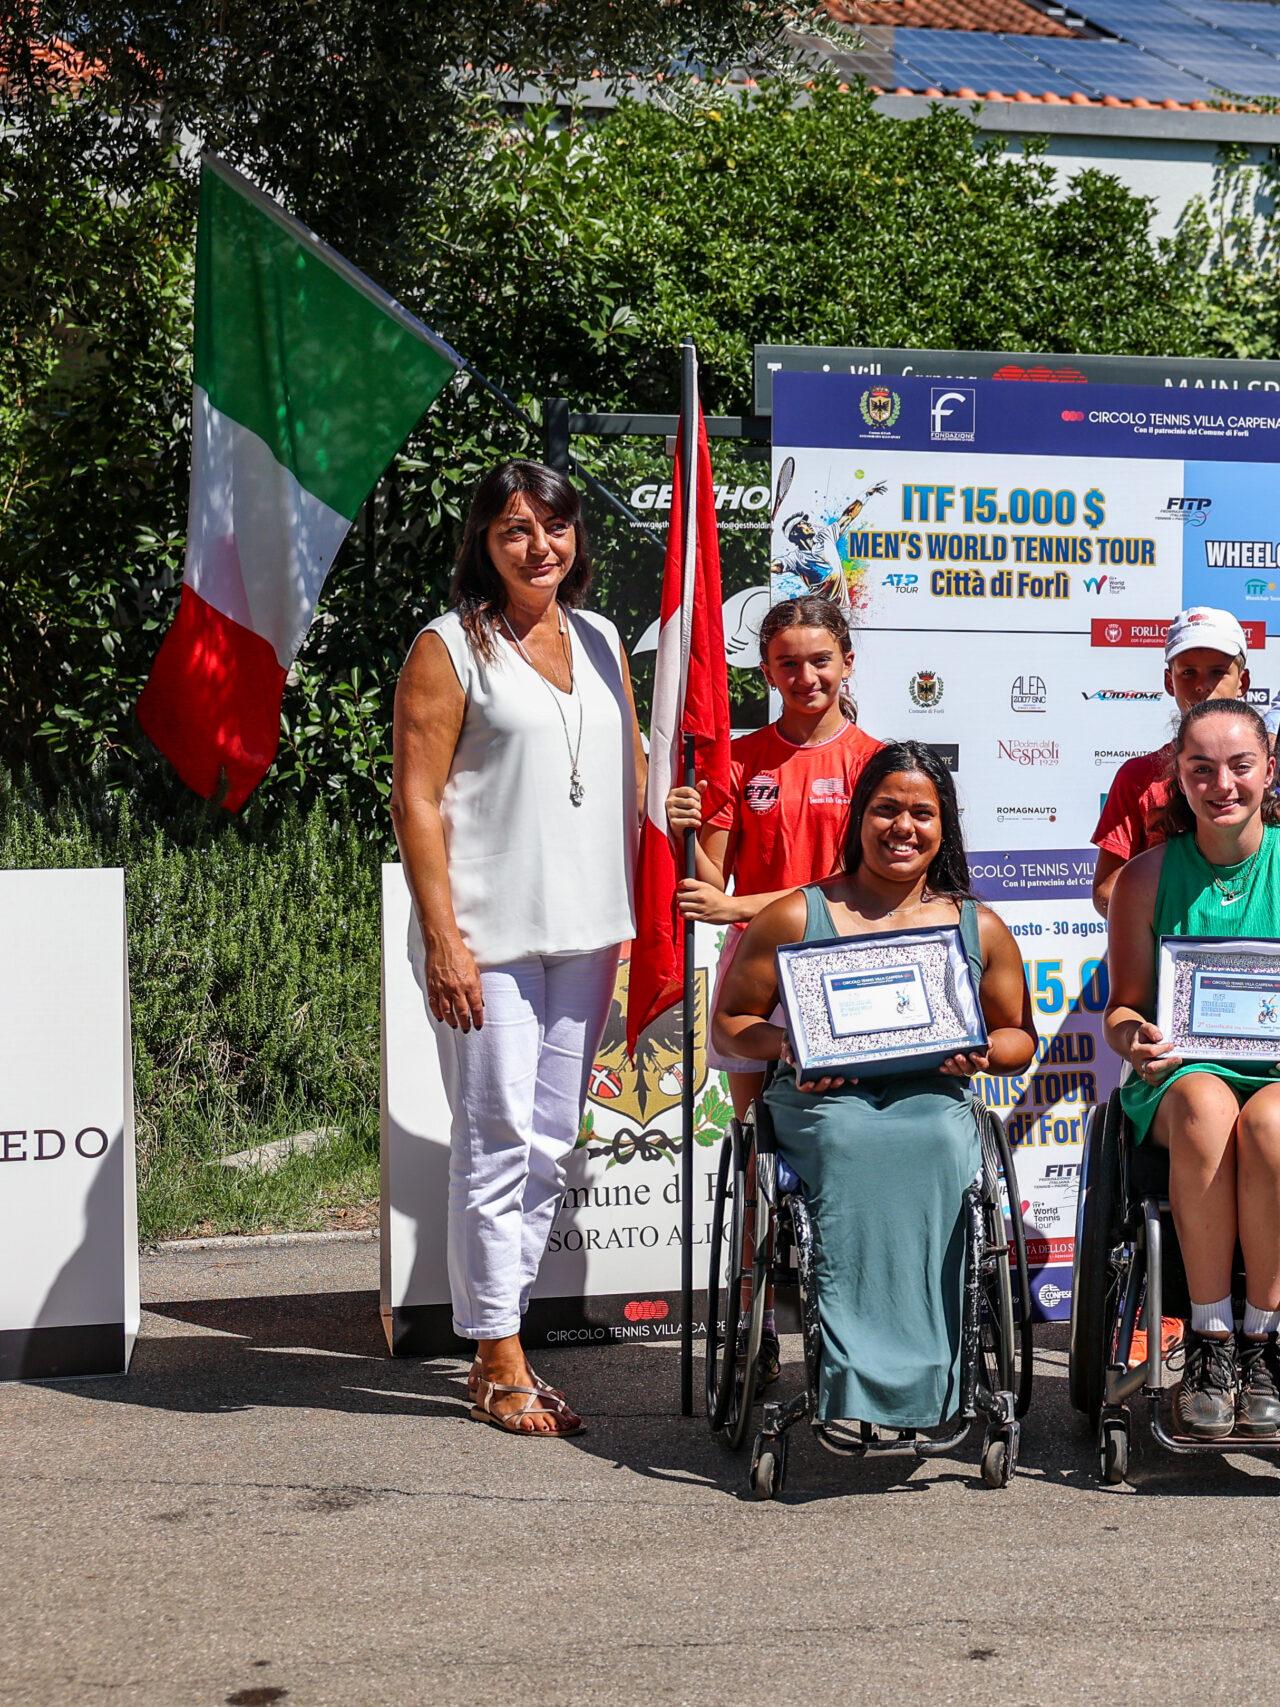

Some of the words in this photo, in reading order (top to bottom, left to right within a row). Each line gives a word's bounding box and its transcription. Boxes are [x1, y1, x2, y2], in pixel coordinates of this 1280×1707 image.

[1088, 411, 1147, 425] CIRCOLO
[1149, 413, 1191, 426] TENNIS
[1193, 415, 1225, 428] VILLA
[931, 432, 975, 440] FONDAZIONE
[1134, 426, 1147, 434] Con
[1154, 427, 1187, 436] patrocinio
[901, 483, 956, 524] ITF
[959, 485, 1078, 527] 15.000
[1082, 487, 1106, 530] $
[1166, 497, 1213, 511] FITP
[925, 532, 1009, 564] WORLD
[1010, 534, 1093, 566] TENNIS
[1095, 536, 1157, 567] TOUR
[881, 573, 919, 586] ATP
[930, 567, 987, 599] Città
[990, 568, 1014, 600] di
[1017, 570, 1071, 600] Forlì
[895, 586, 919, 594] TOUR
[1245, 581, 1267, 596] ITF
[1131, 624, 1159, 637] FORLÌ
[1011, 676, 1047, 695] ALEA
[1013, 695, 1031, 704] 2007
[1032, 696, 1047, 704] SNC
[996, 740, 1059, 766] Nespoli
[996, 806, 1057, 814] ROMAGNAUTO
[1020, 863, 1069, 877] TENNIS
[1002, 879, 1018, 888] Con
[1020, 879, 1026, 888] il
[1027, 878, 1065, 889] patrocinio
[1066, 878, 1078, 886] del
[1053, 920, 1069, 935] 30
[1028, 1071, 1098, 1107] TOUR
[1008, 1112, 1034, 1148] di
[1033, 1207, 1058, 1216] World
[1034, 1215, 1061, 1223] Tennis
[546, 1327, 605, 1342] CIRCOLO
[608, 1325, 651, 1338] TENNIS
[653, 1323, 684, 1335] VILLA
